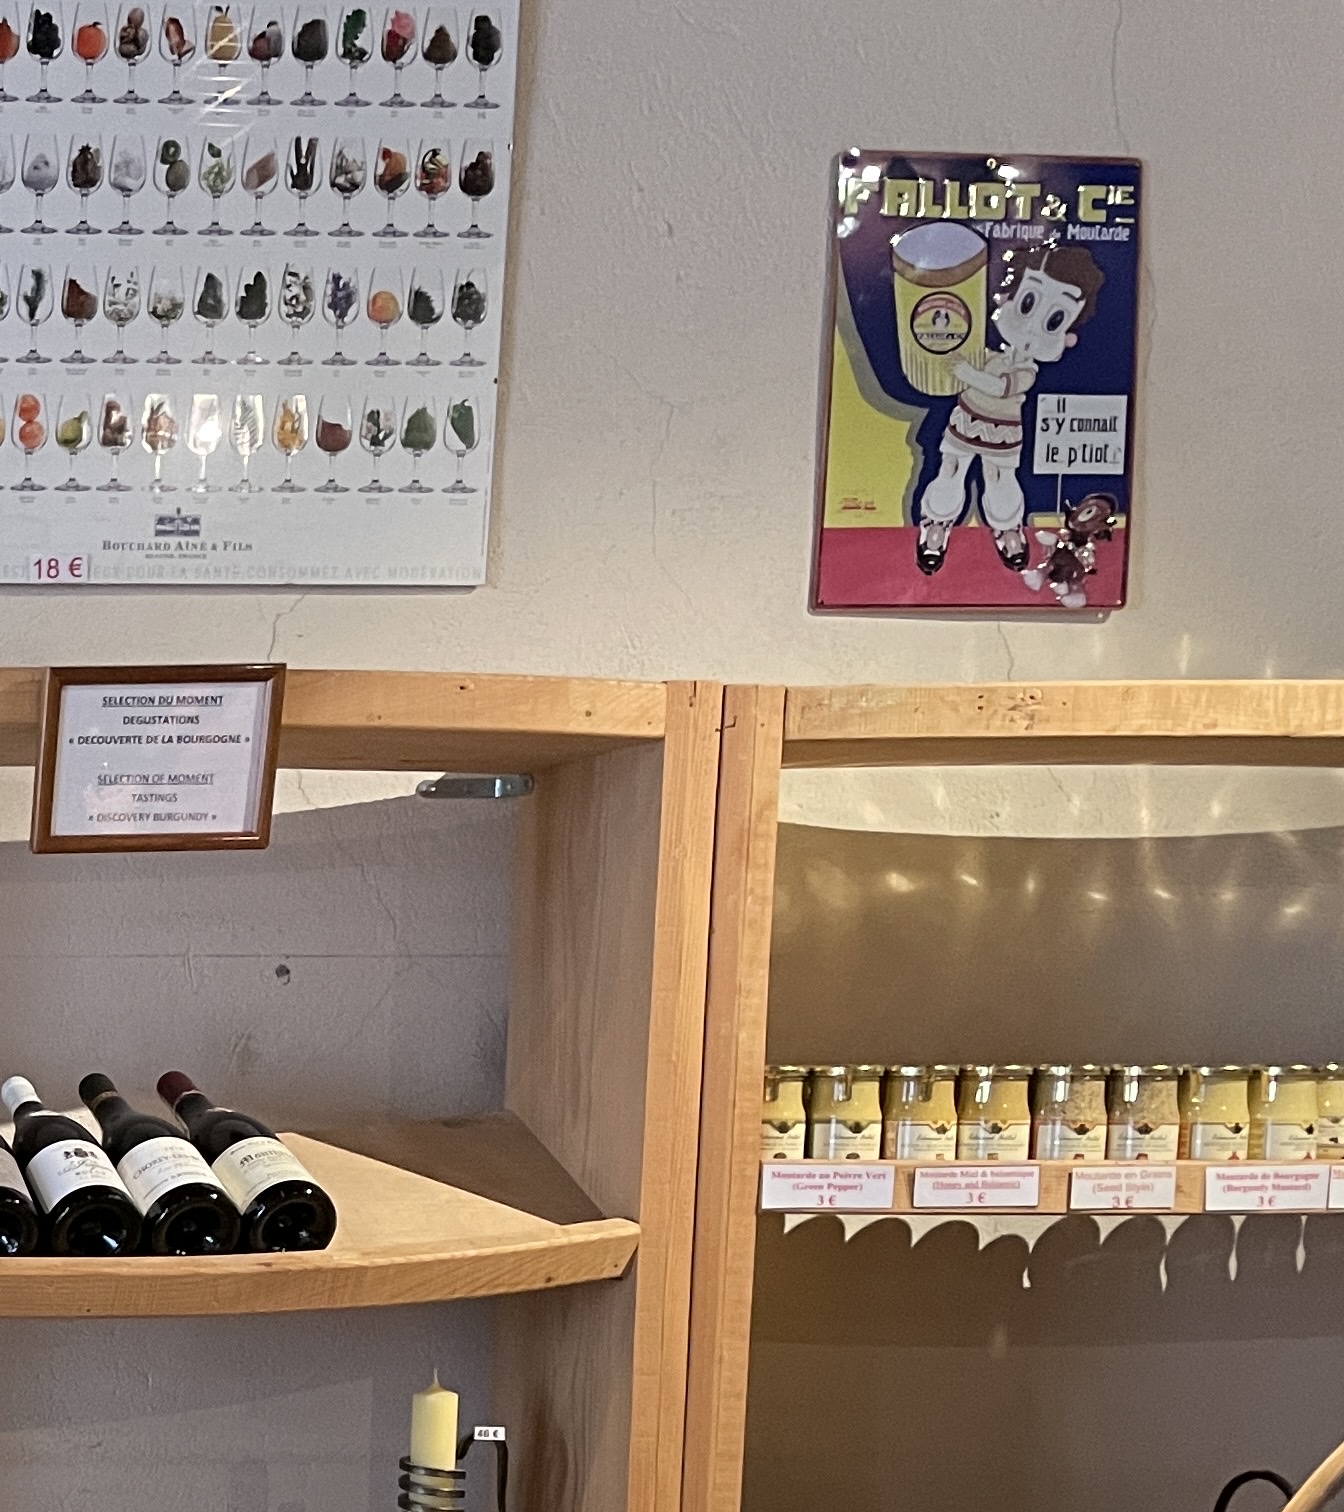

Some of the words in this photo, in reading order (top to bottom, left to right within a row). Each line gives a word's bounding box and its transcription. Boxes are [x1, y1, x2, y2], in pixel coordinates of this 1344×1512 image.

[841, 178, 1041, 220] FALLOT
[984, 221, 1045, 240] Fabrique
[1067, 223, 1131, 242] Moutarde
[1045, 443, 1059, 464] le
[102, 540, 171, 552] BOUCHARD
[33, 557, 60, 580] 18
[68, 556, 83, 579] €
[102, 696, 154, 707] SELECTION
[158, 696, 174, 706] DU
[176, 695, 223, 706] MOMENT
[122, 714, 200, 726] DEGUSTATIONS
[77, 735, 143, 746] DECOUVERTE
[146, 735, 159, 745] DE
[162, 734, 174, 744] LA
[177, 733, 242, 745] BOURGOGNE
[168, 773, 214, 785] MOMENT
[132, 793, 178, 803] TASTINGS
[97, 812, 151, 823] DISCOVERY
[771, 1171, 817, 1180] Moutarde
[833, 1171, 863, 1179] Poivre
[865, 1171, 886, 1179] Vert
[816, 1195, 824, 1205] 3
[828, 1195, 837, 1205] €
[966, 1192, 974, 1203] 3
[977, 1192, 987, 1203] €
[1111, 1196, 1120, 1208] 3
[1124, 1196, 1134, 1208] €
[1256, 1195, 1264, 1207] 3
[1268, 1195, 1276, 1207] €
